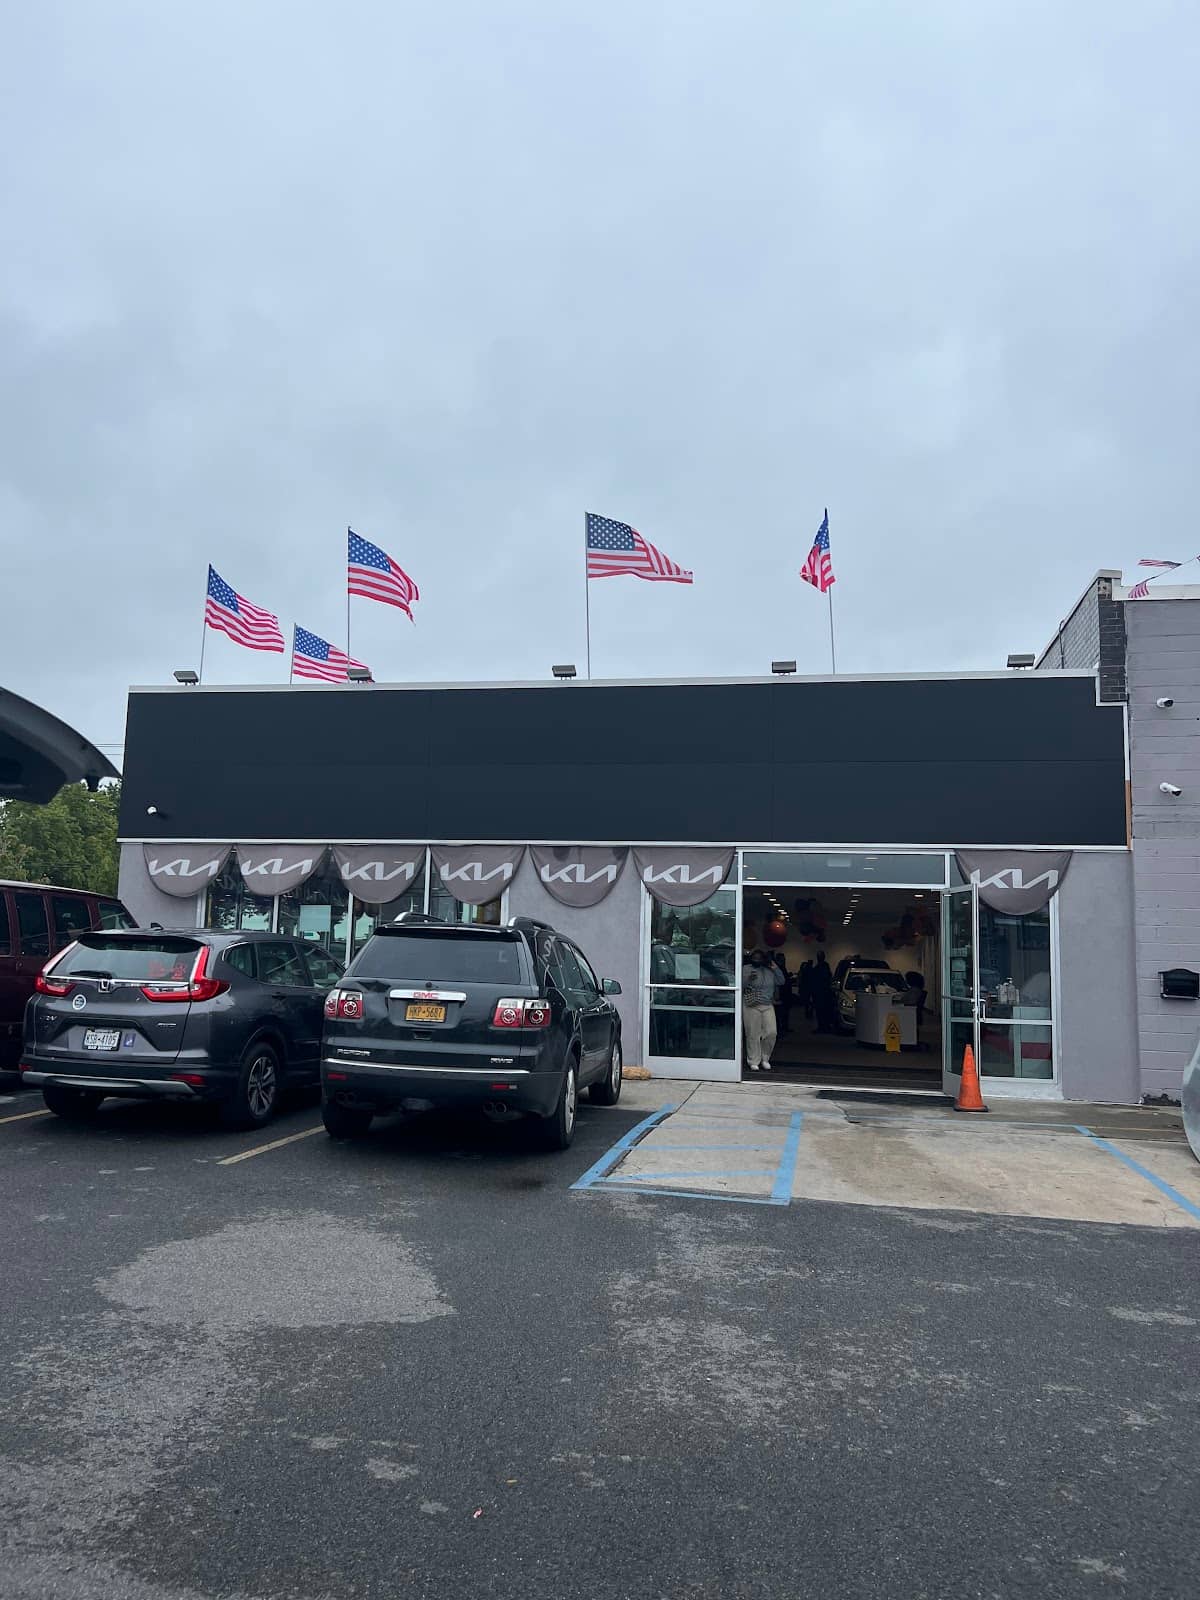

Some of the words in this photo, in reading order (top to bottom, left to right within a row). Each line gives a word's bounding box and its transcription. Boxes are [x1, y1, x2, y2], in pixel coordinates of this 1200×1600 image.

[149, 859, 219, 876] KIA
[241, 859, 312, 875] KIA
[341, 862, 414, 880] KIA
[440, 862, 513, 881] KIA
[541, 864, 617, 883] KIA
[644, 864, 723, 883] KIA
